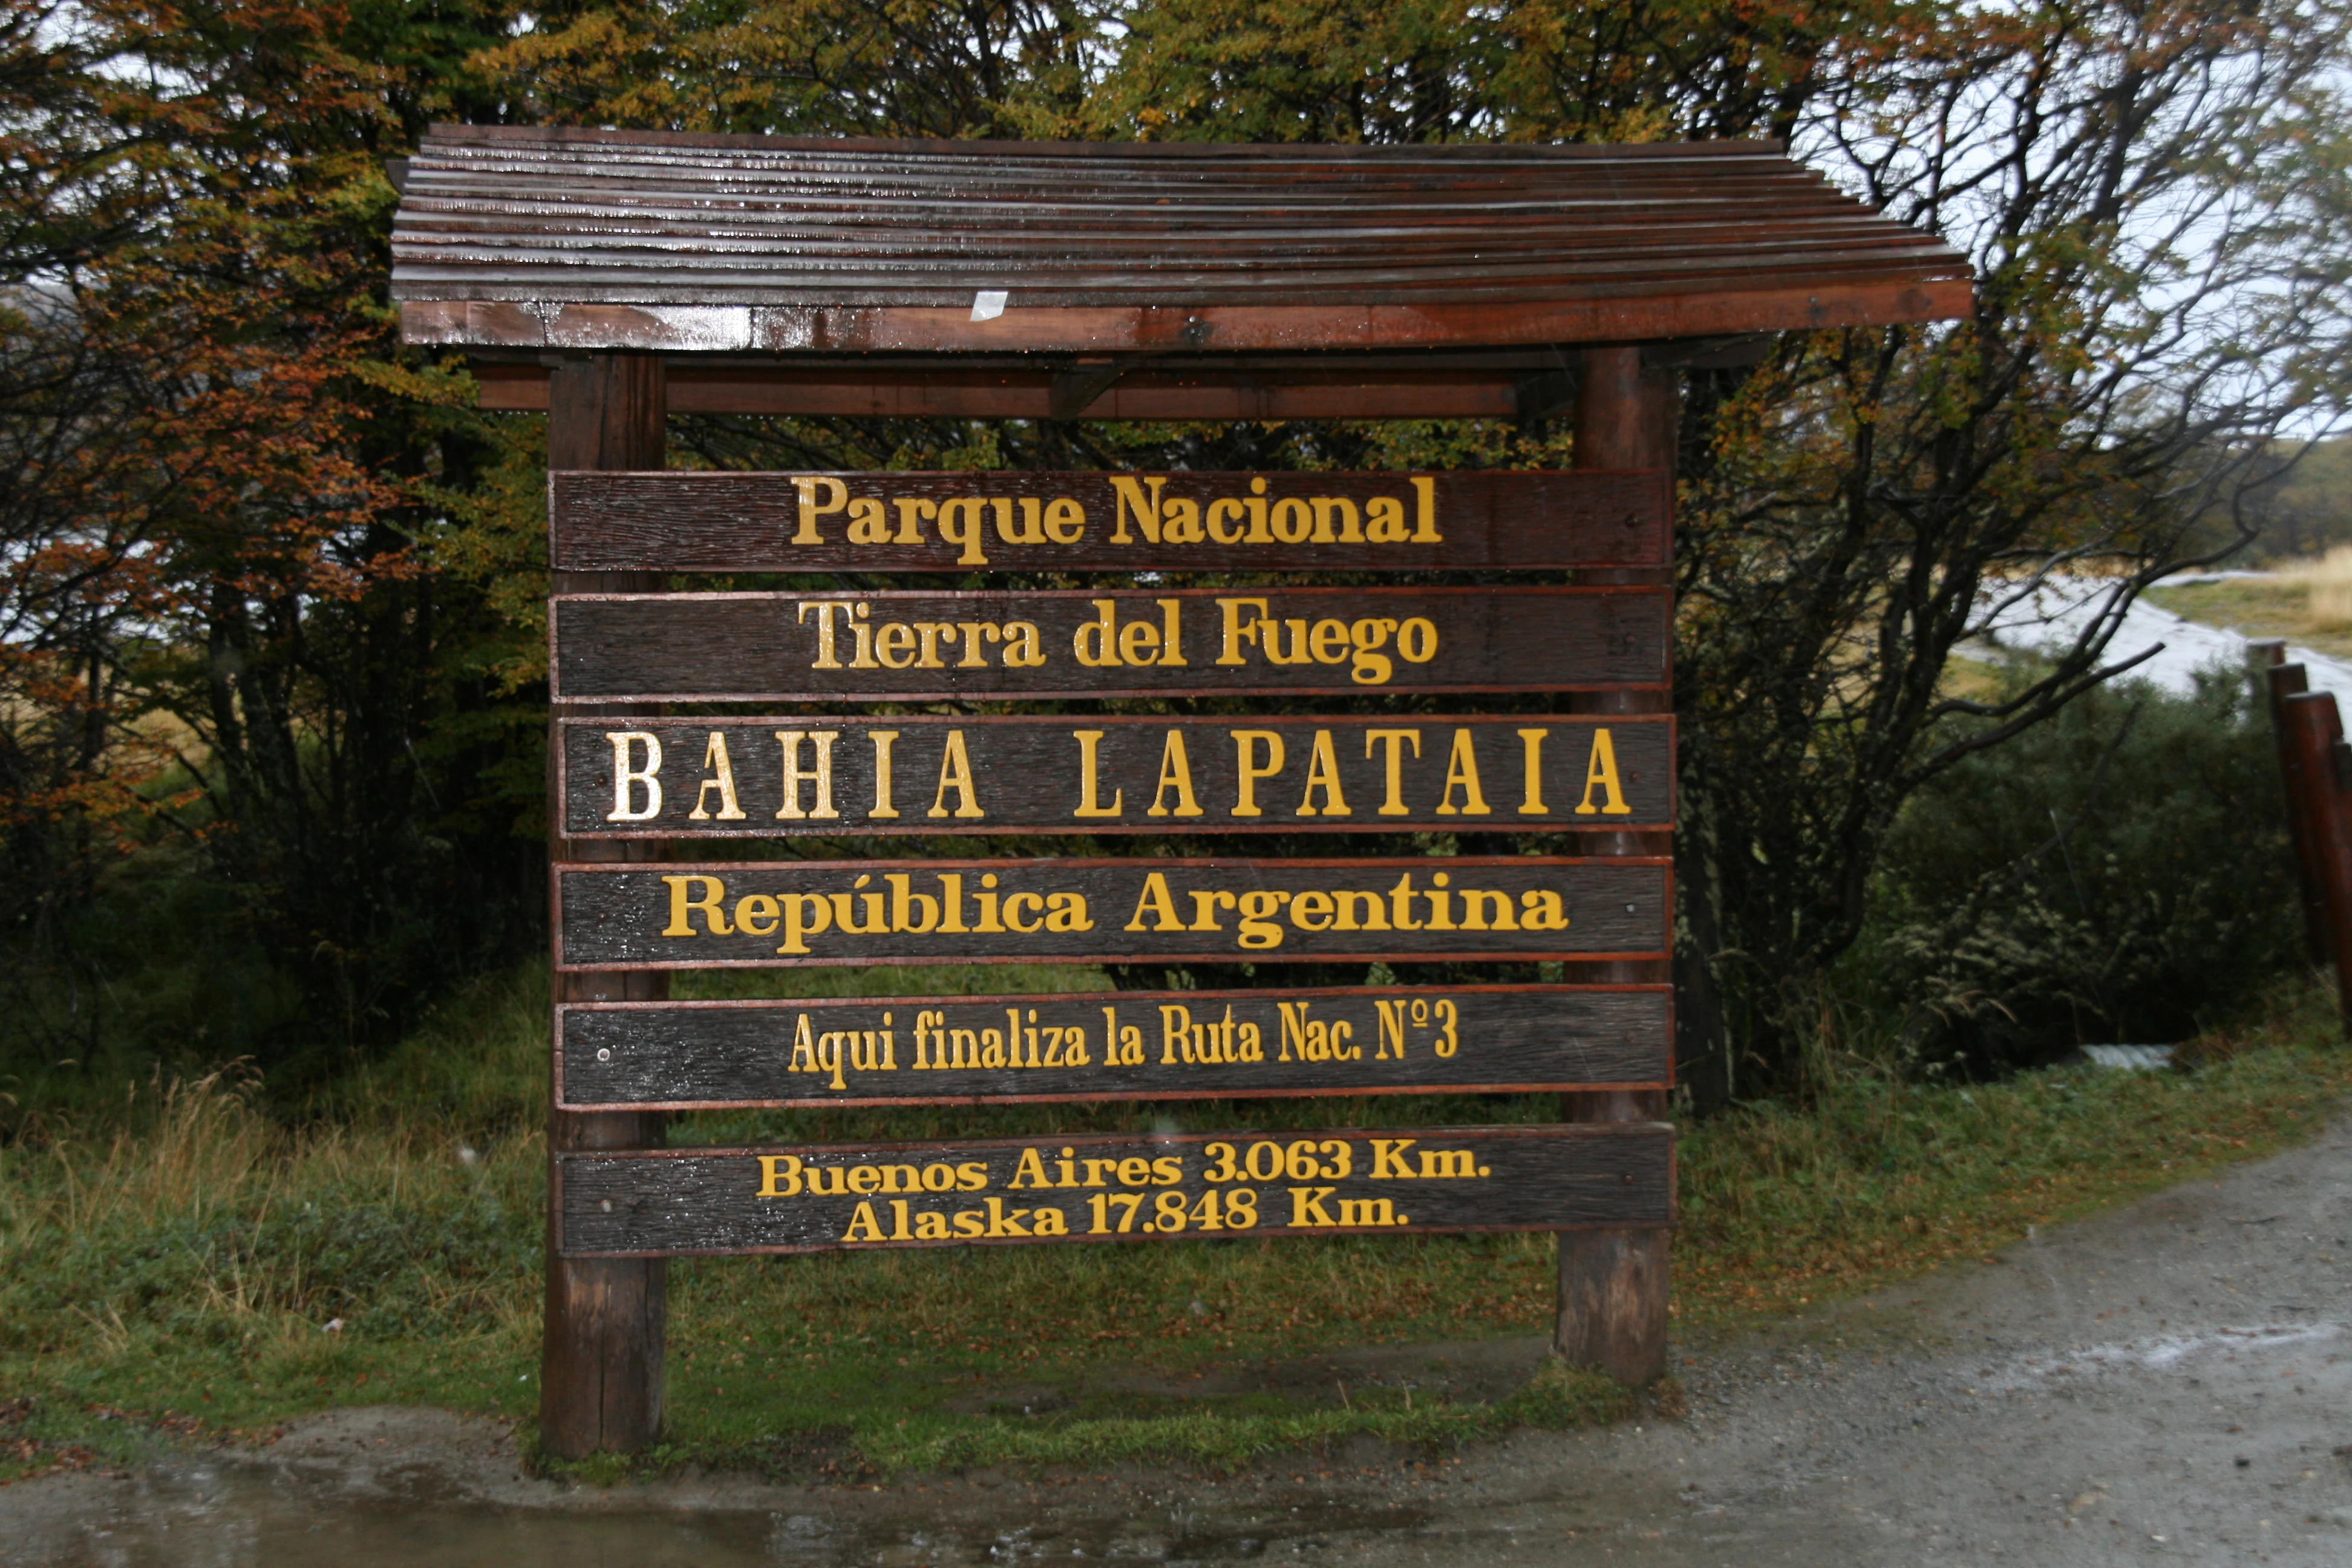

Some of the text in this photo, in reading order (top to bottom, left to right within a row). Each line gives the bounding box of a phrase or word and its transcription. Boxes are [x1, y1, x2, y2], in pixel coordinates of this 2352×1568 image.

[791, 475, 1442, 566] Parque Nacional
[798, 598, 1439, 685] Tierra del Fuego
[605, 728, 1632, 823] BAHIA LAPATAIA
[662, 871, 1569, 955] República Argentina
[787, 1011, 898, 1091] Aqui
[912, 1008, 1092, 1071] finaliza
[1102, 1006, 1146, 1067] la
[1158, 1004, 1265, 1065] Ruta
[1276, 1001, 1362, 1062] Nac.
[756, 1138, 1492, 1198] Buenos Aires 3.063 Km.
[839, 1186, 1411, 1244] Alaska 17.848 Km.
